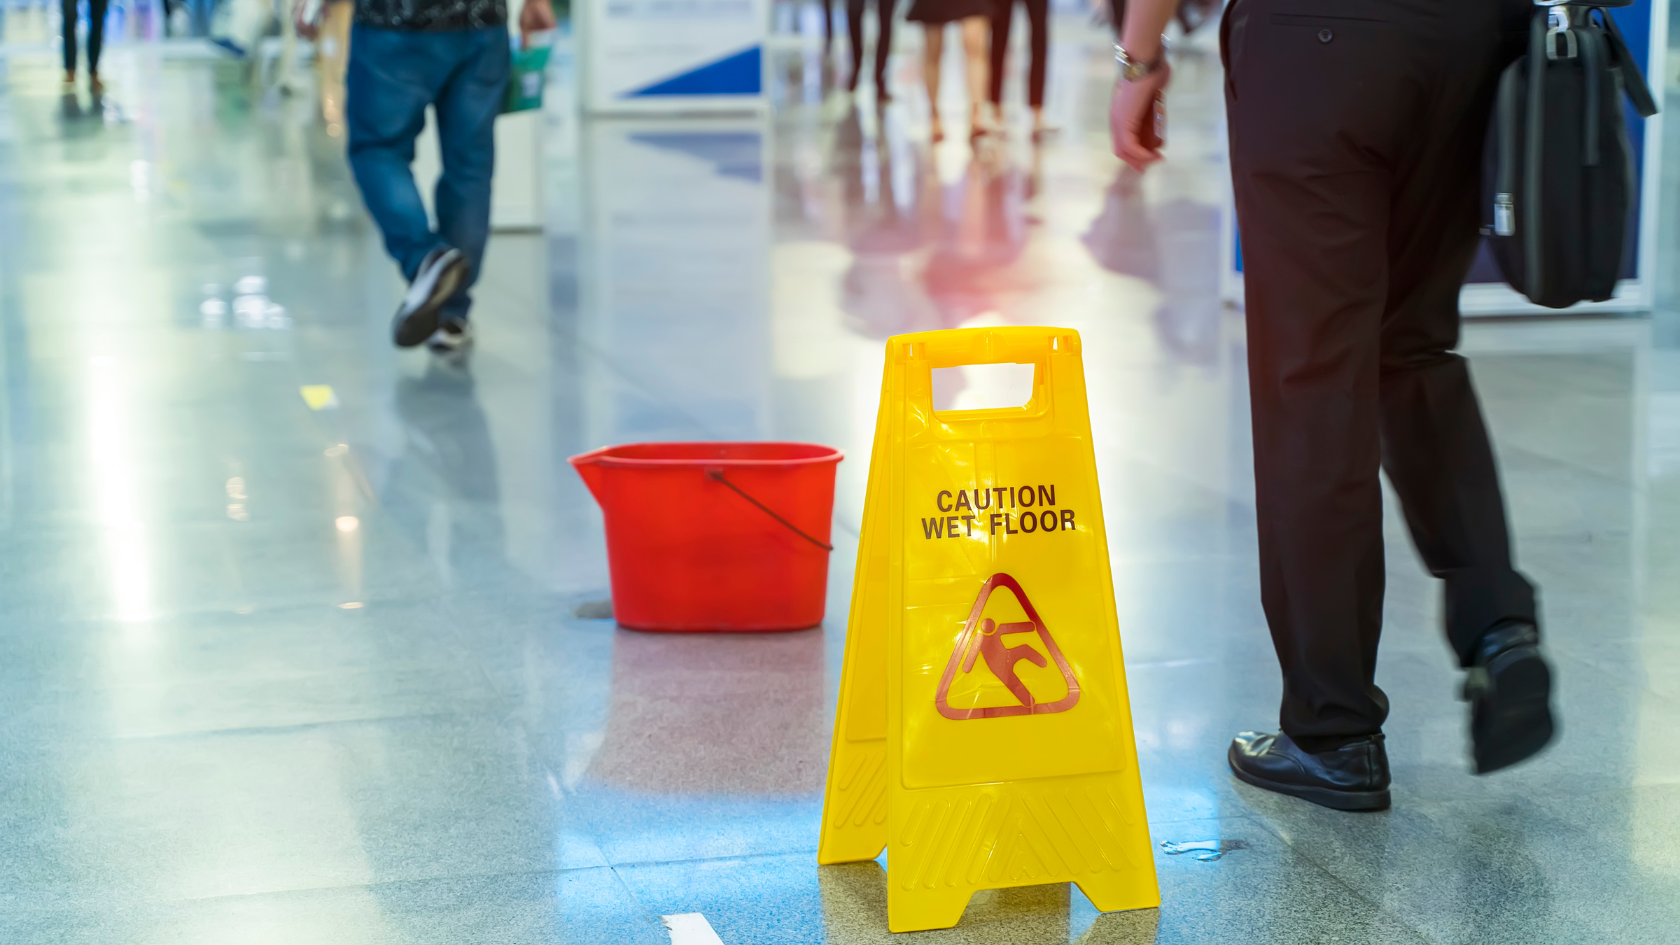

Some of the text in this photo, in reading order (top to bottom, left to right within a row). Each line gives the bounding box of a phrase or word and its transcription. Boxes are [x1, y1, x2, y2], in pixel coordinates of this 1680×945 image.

[936, 484, 1056, 513] CAUTION
[921, 508, 1077, 540] WET FLOOR
